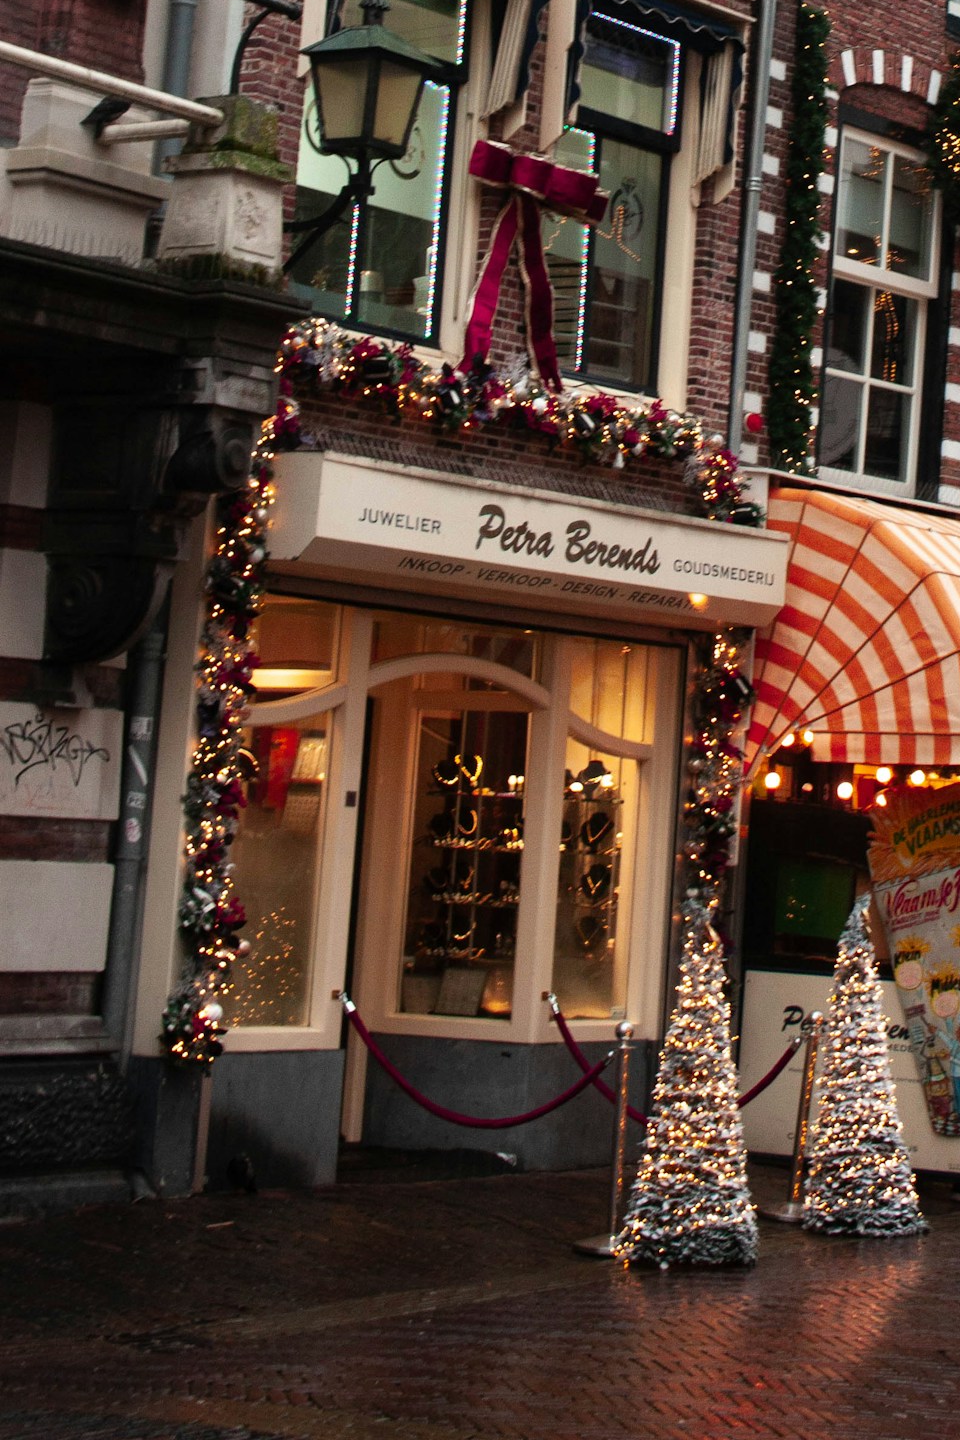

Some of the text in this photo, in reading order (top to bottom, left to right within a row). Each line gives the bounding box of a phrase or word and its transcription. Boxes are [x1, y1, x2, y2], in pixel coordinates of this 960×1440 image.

[358, 503, 775, 587] JUWELIER Petra Berends GOUDSMEDERIJ
[398, 556, 466, 576] INKOOP
[476, 568, 552, 588] VERKOOP
[561, 580, 619, 599] DESIGN
[885, 877, 954, 918] Vlaamse
